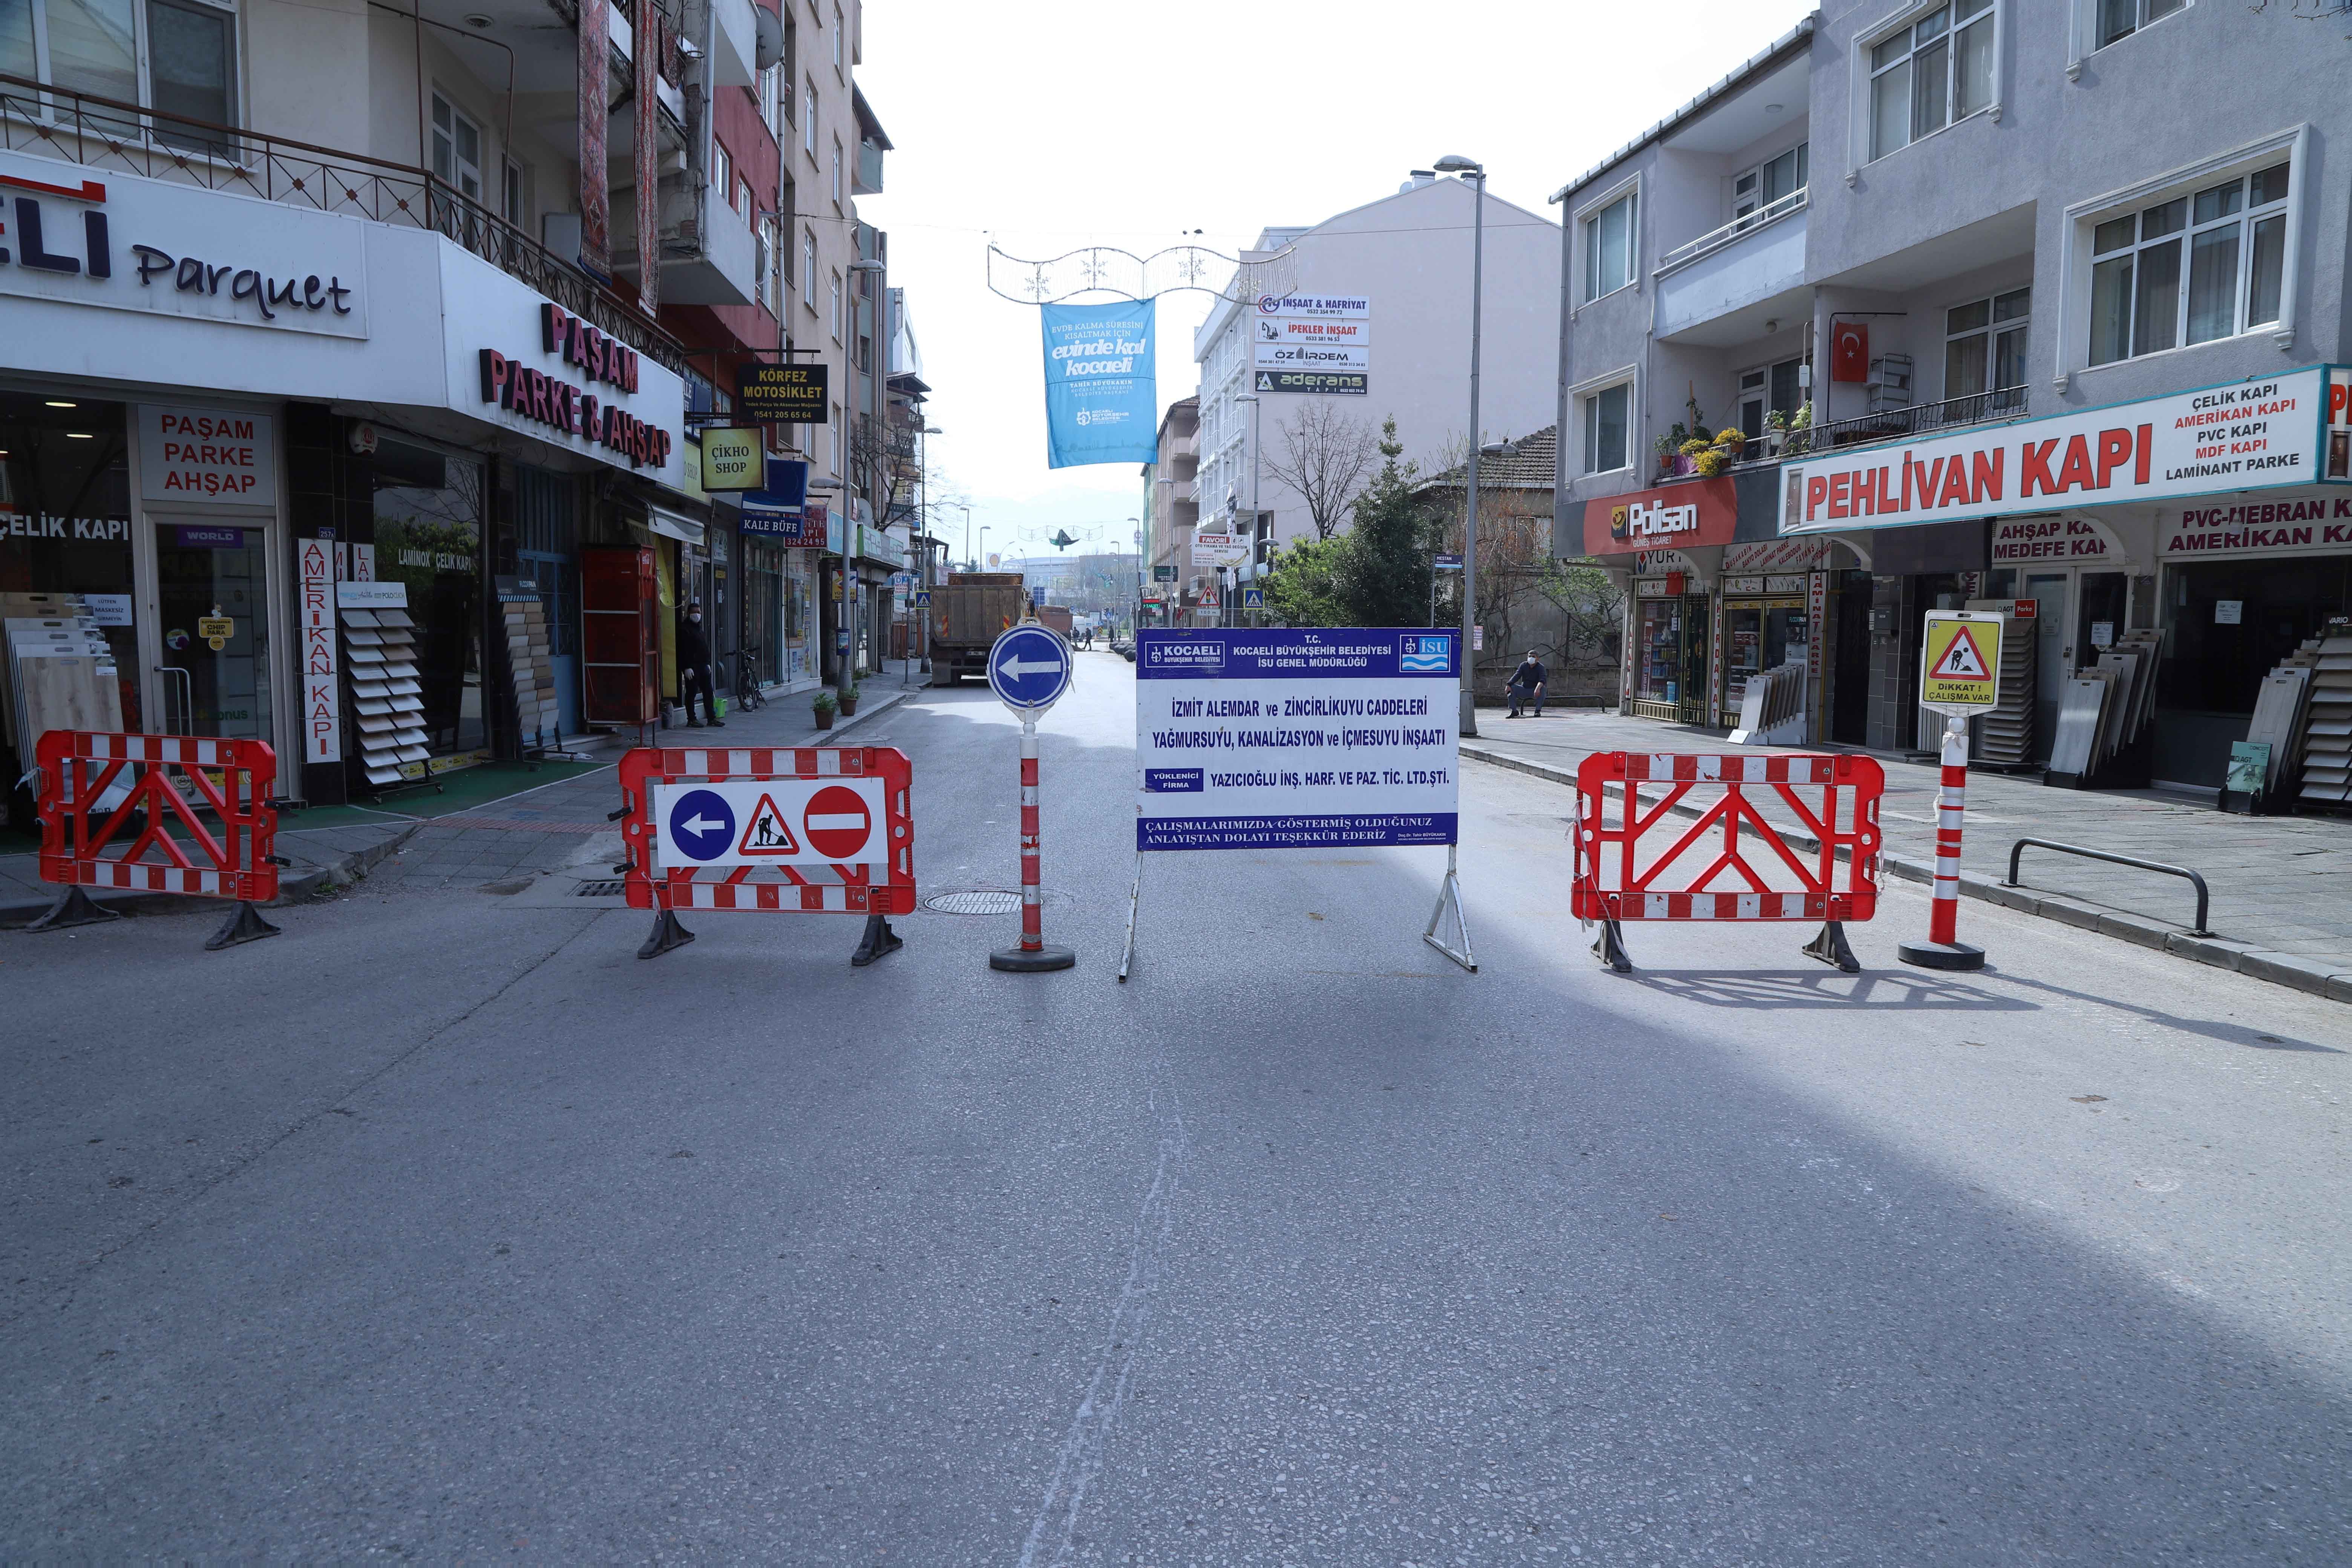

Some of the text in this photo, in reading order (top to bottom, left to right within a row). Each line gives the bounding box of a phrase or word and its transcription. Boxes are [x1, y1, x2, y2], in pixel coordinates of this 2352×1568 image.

[132, 244, 351, 319] Parquet
[1316, 298, 1366, 309] & HAFRİYAT
[1052, 320, 1143, 333] EVDE KALMA SÜRESİNİ
[1065, 329, 1131, 340] KISALTMAK İÇİN
[1288, 322, 1357, 337] İPEKLER İNŞAAT
[541, 303, 638, 394] PAŞAM
[1052, 339, 1146, 359] evinde kal
[759, 368, 807, 382] KÖRFEZ
[1066, 357, 1133, 376] kocaeli
[1280, 374, 1363, 386] aderans
[744, 384, 822, 398] MOTOSİKLET
[2192, 384, 2277, 412] ÇELİK KAPI
[480, 349, 671, 468] PARKE & AHŞAP
[2174, 399, 2295, 429] AMERİKAN KAPI
[162, 415, 254, 440] PAŞAM
[2197, 422, 2267, 443] PVC KAPI
[165, 443, 254, 466] PARKE
[712, 444, 749, 460] ÇİKHO
[2196, 439, 2267, 459] MDF KAPI
[688, 463, 697, 480] SHOP
[716, 462, 746, 473] SHOP
[1807, 423, 2153, 522] PEHLİVAN KAPI
[2166, 453, 2299, 480] LAMİNANT PARKE
[165, 471, 256, 496] AHŞAP
[1629, 500, 1696, 536] Polisan
[2182, 500, 2325, 529] PVC-MEBRAN
[74, 518, 129, 540] KAPI
[744, 520, 797, 532] KALE BÜFE
[2000, 523, 2061, 541] AHŞAP
[187, 532, 234, 540] WORLD
[1633, 535, 1672, 548] GÜNEŞ TİCARET
[2168, 527, 2312, 551] AMERİKAN
[1754, 543, 1768, 559] DOLABI
[1776, 540, 1789, 555] PARKE
[1778, 544, 1801, 566] KALEBODUR
[1796, 544, 1814, 564] FAYANS
[1811, 542, 1831, 564] HIRDAVAT
[1994, 541, 2065, 559] MEDEFE
[399, 547, 471, 572] LAMİNOX ÇELİK KAPI
[1742, 556, 1753, 568] BANYO
[1305, 635, 1321, 644] T.C.
[1420, 640, 1448, 653] İSU
[304, 544, 332, 754] AMERİKAN KAPI
[1164, 645, 1220, 655] KOCAELİ
[1233, 644, 1391, 657] KOCAELİ BÜYÜKŞEHİR BELEDİYESİ
[1811, 637, 1820, 673] PARKE
[1258, 656, 1367, 667] İSU GENEL MÜDÜRLÜĞÜ
[1929, 692, 1969, 701] ÇALIŞMA
[217, 710, 248, 720] onus
[1172, 695, 1427, 717] İZMİT ALEMDAR ve ZİNCİRLİKUYU CADDELERİ
[1153, 726, 1445, 751] YAĞMURSUYU, KANALİZASYON ve İÇMESUYU İNŞAATI
[1210, 767, 1449, 789] YAZICIOĞLU İNŞ. HARF. VE PAZ. TİC. LTD.ŞTİ.
[1146, 816, 1432, 833] ÇALIŞMALARIMIZDA GÖSTERMİŞ OLDUĞUNUZ
[1146, 829, 1386, 845] ANLAYIŞTAN DOLAYI TEŞEKKÜR EDERİZ
